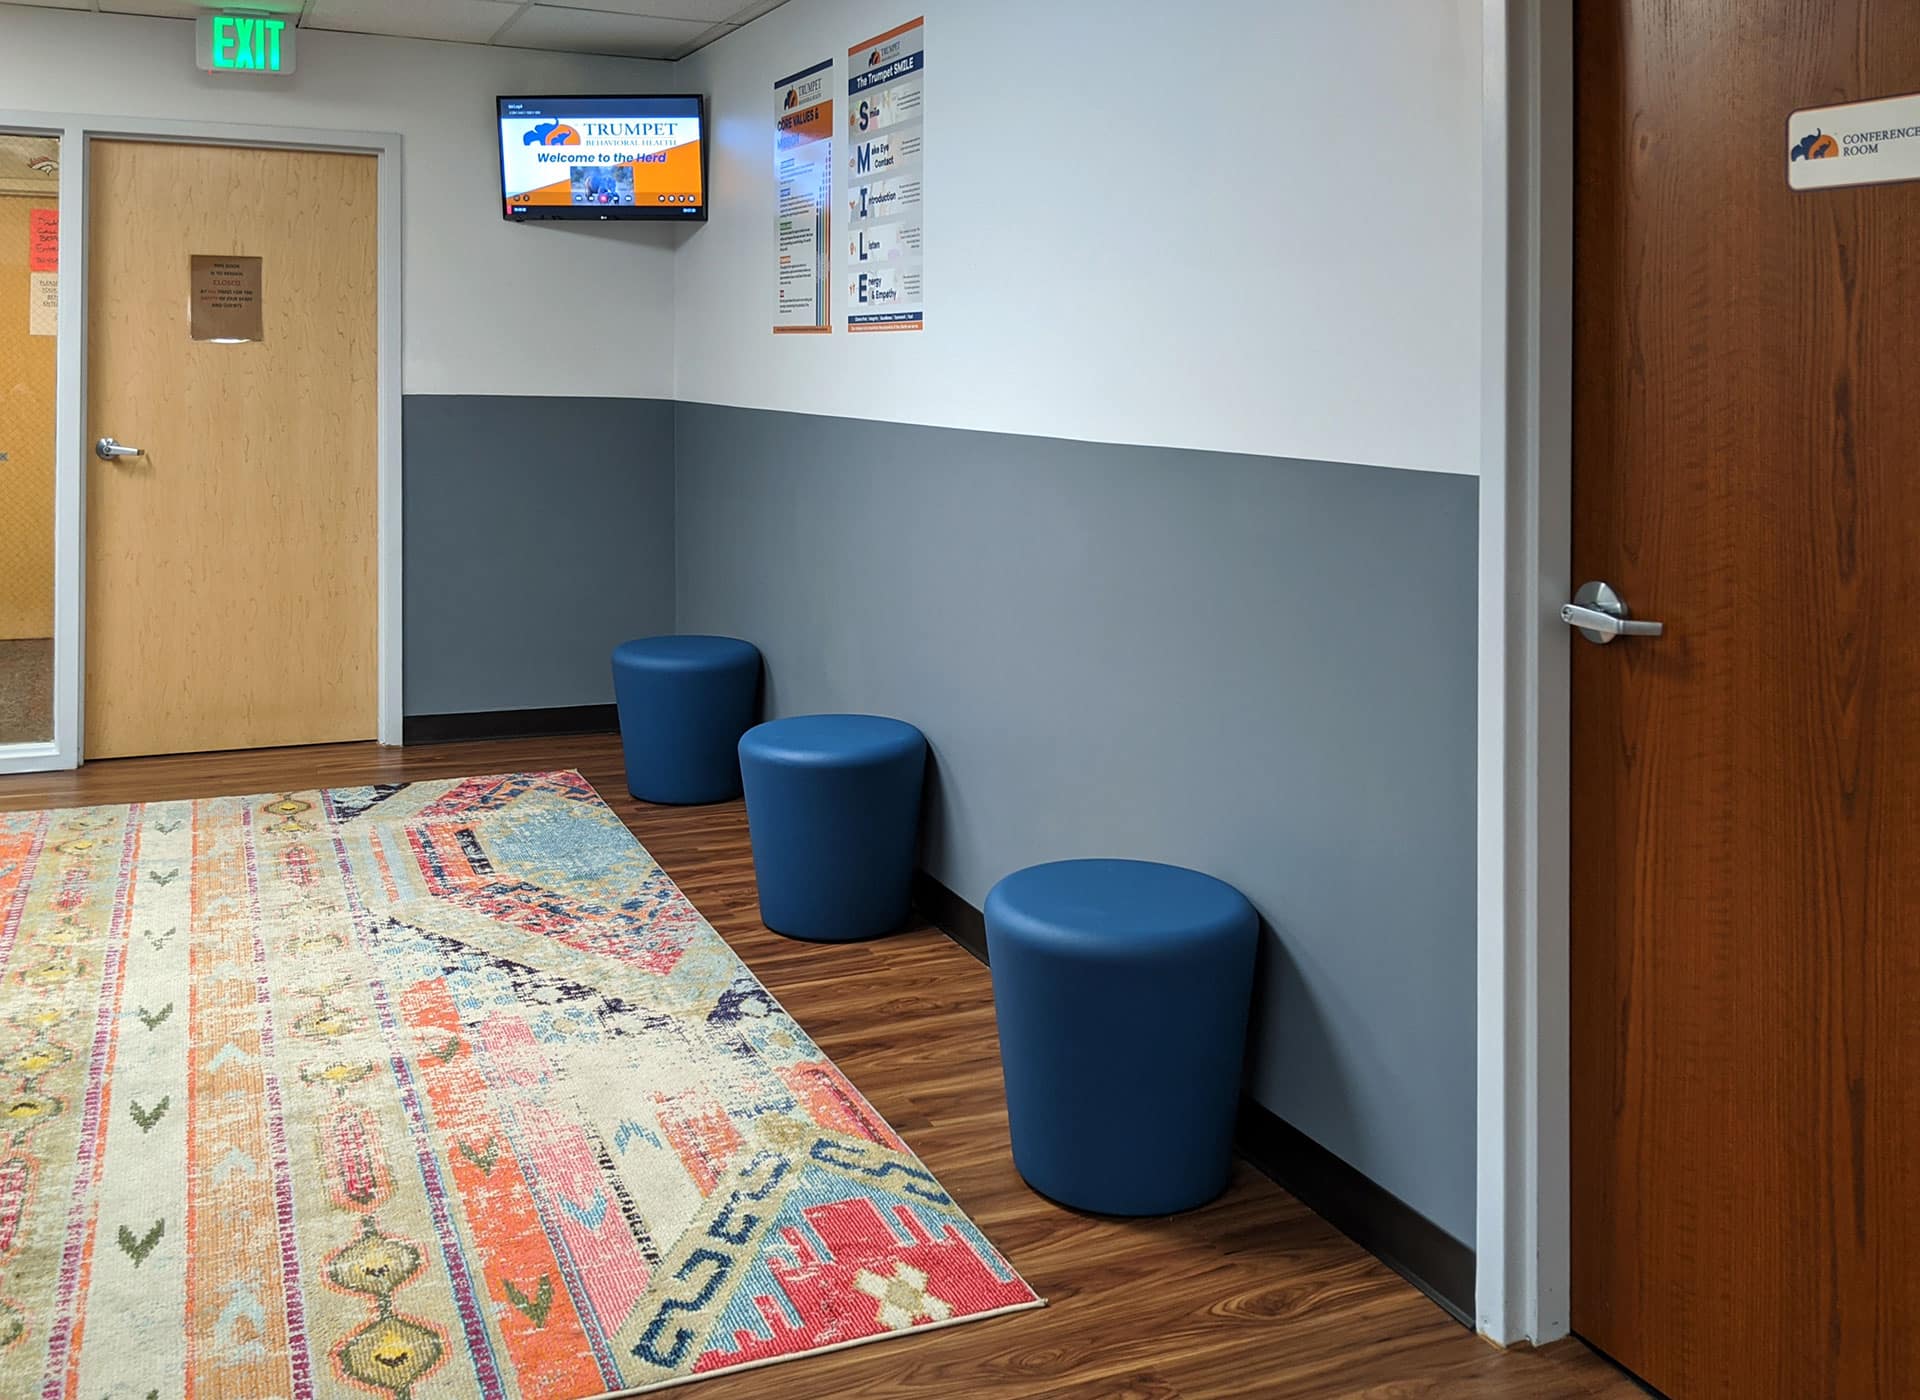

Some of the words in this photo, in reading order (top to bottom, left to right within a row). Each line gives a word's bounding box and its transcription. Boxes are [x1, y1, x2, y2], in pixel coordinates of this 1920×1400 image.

[213, 16, 285, 71] EXIT
[857, 76, 868, 88] The
[868, 66, 893, 84] Trumpet
[894, 57, 914, 75] SMILE
[799, 78, 822, 96] TRUMPET
[777, 116, 792, 132] CORE
[793, 110, 814, 127] VALUES
[815, 108, 820, 120] &
[583, 122, 678, 137] TRUMPET
[1843, 126, 1920, 145] CONFERENCE
[585, 138, 640, 147] BEHAVIORAL
[642, 138, 678, 147] HEALTH
[537, 153, 596, 163] Welcome
[598, 153, 611, 163] to
[613, 152, 634, 163] the
[636, 152, 667, 163] Herd
[1843, 144, 1879, 157] ROOM
[874, 156, 894, 169] Contact
[875, 289, 897, 301] Empathy
